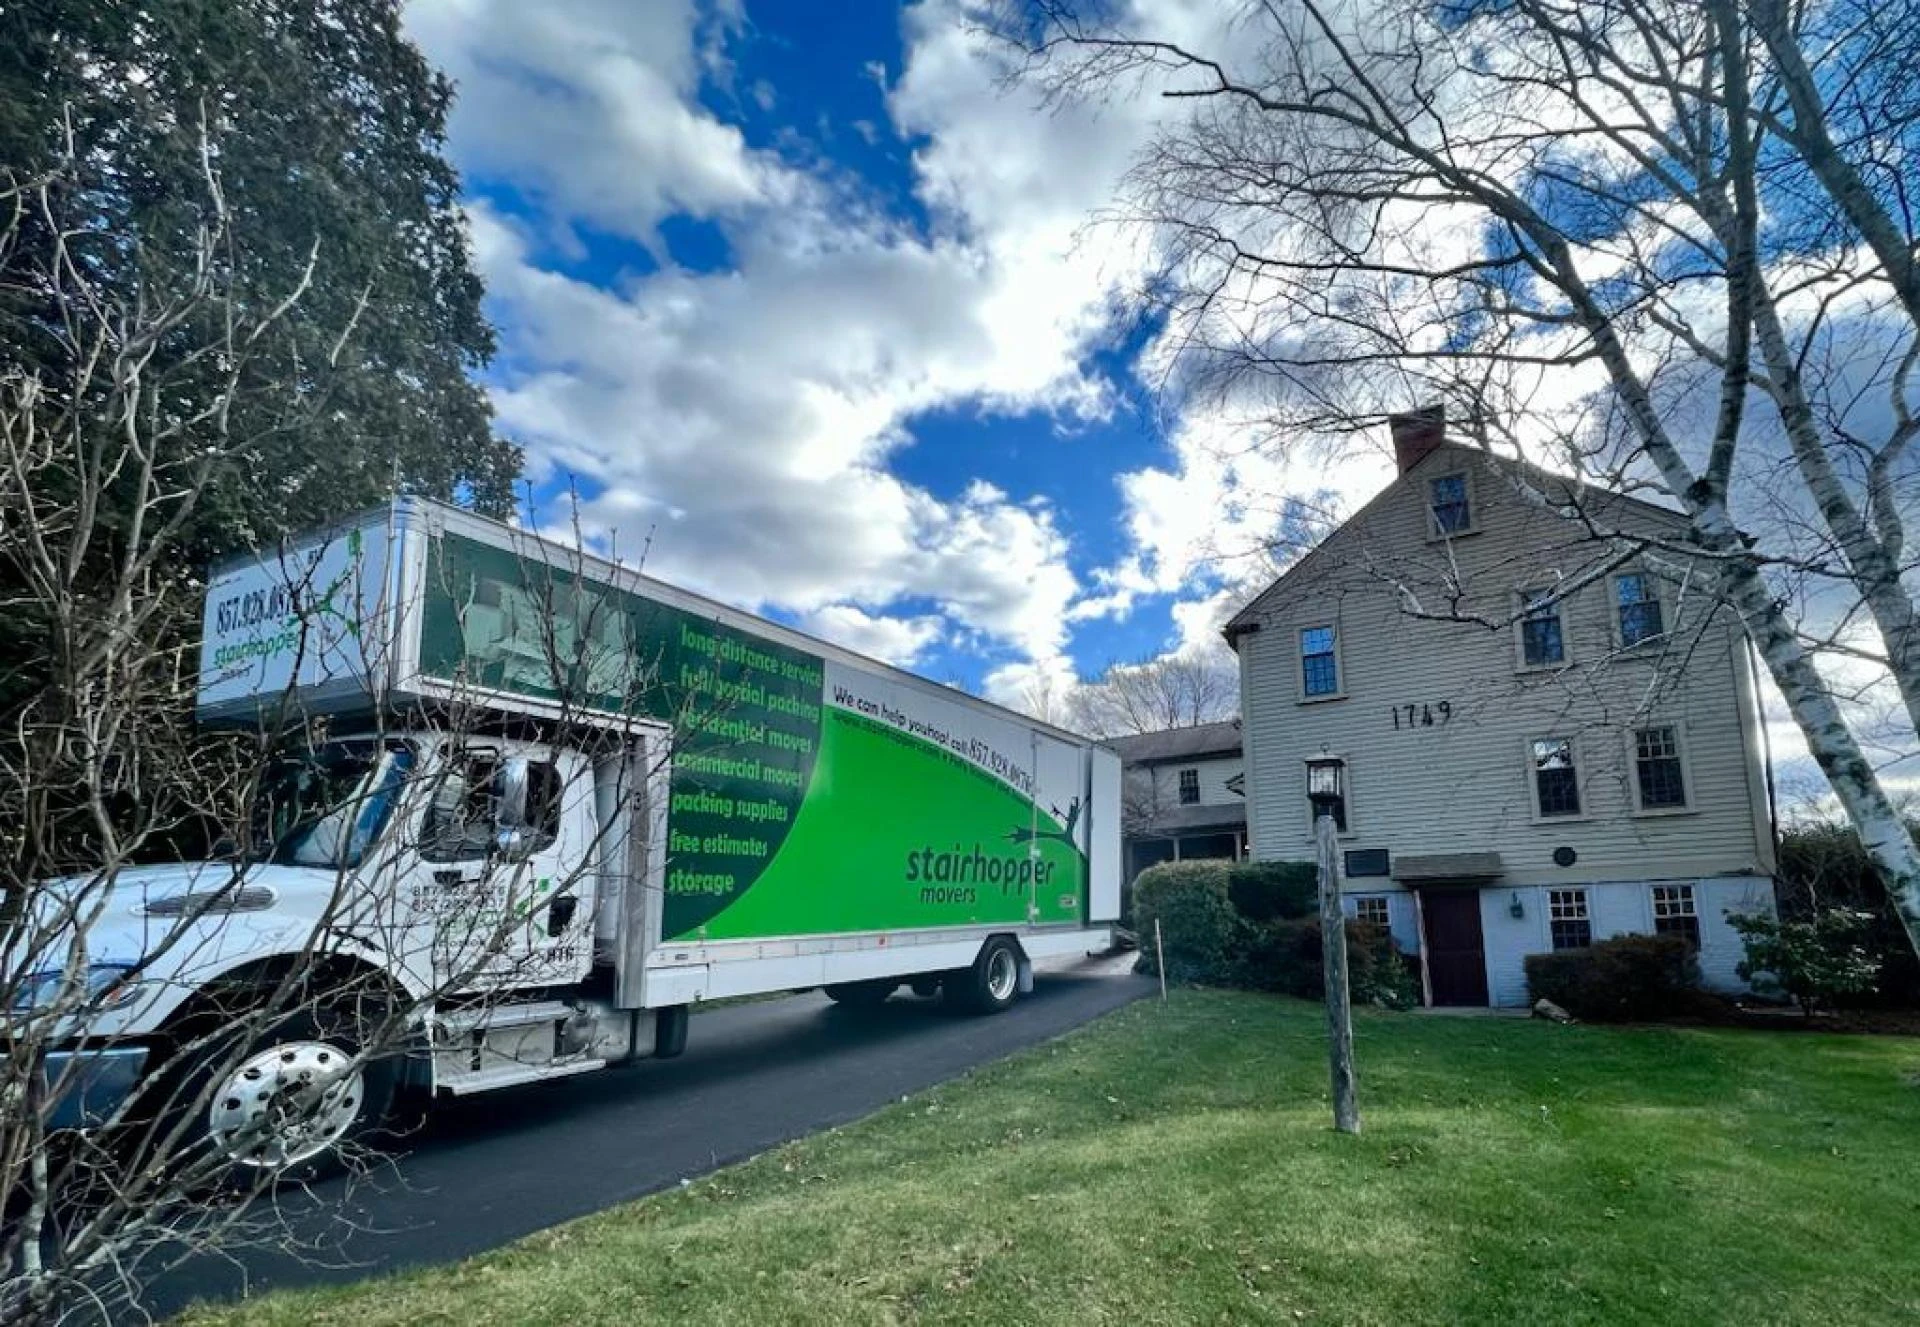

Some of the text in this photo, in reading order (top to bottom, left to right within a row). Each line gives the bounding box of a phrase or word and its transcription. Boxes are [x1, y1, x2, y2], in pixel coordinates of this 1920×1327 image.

[682, 623, 716, 657] long
[721, 637, 778, 673] distance
[768, 694, 820, 723] packing
[834, 683, 853, 707] We
[856, 698, 879, 716] can
[882, 702, 906, 729] help
[1392, 700, 1450, 730] 1749
[769, 731, 812, 752] moves
[674, 752, 760, 780] commercial
[672, 789, 788, 822] packing supplies
[671, 828, 767, 857] free estimates
[669, 869, 734, 896] storage
[906, 843, 1055, 896] stairhopper
[920, 887, 975, 904] movers
